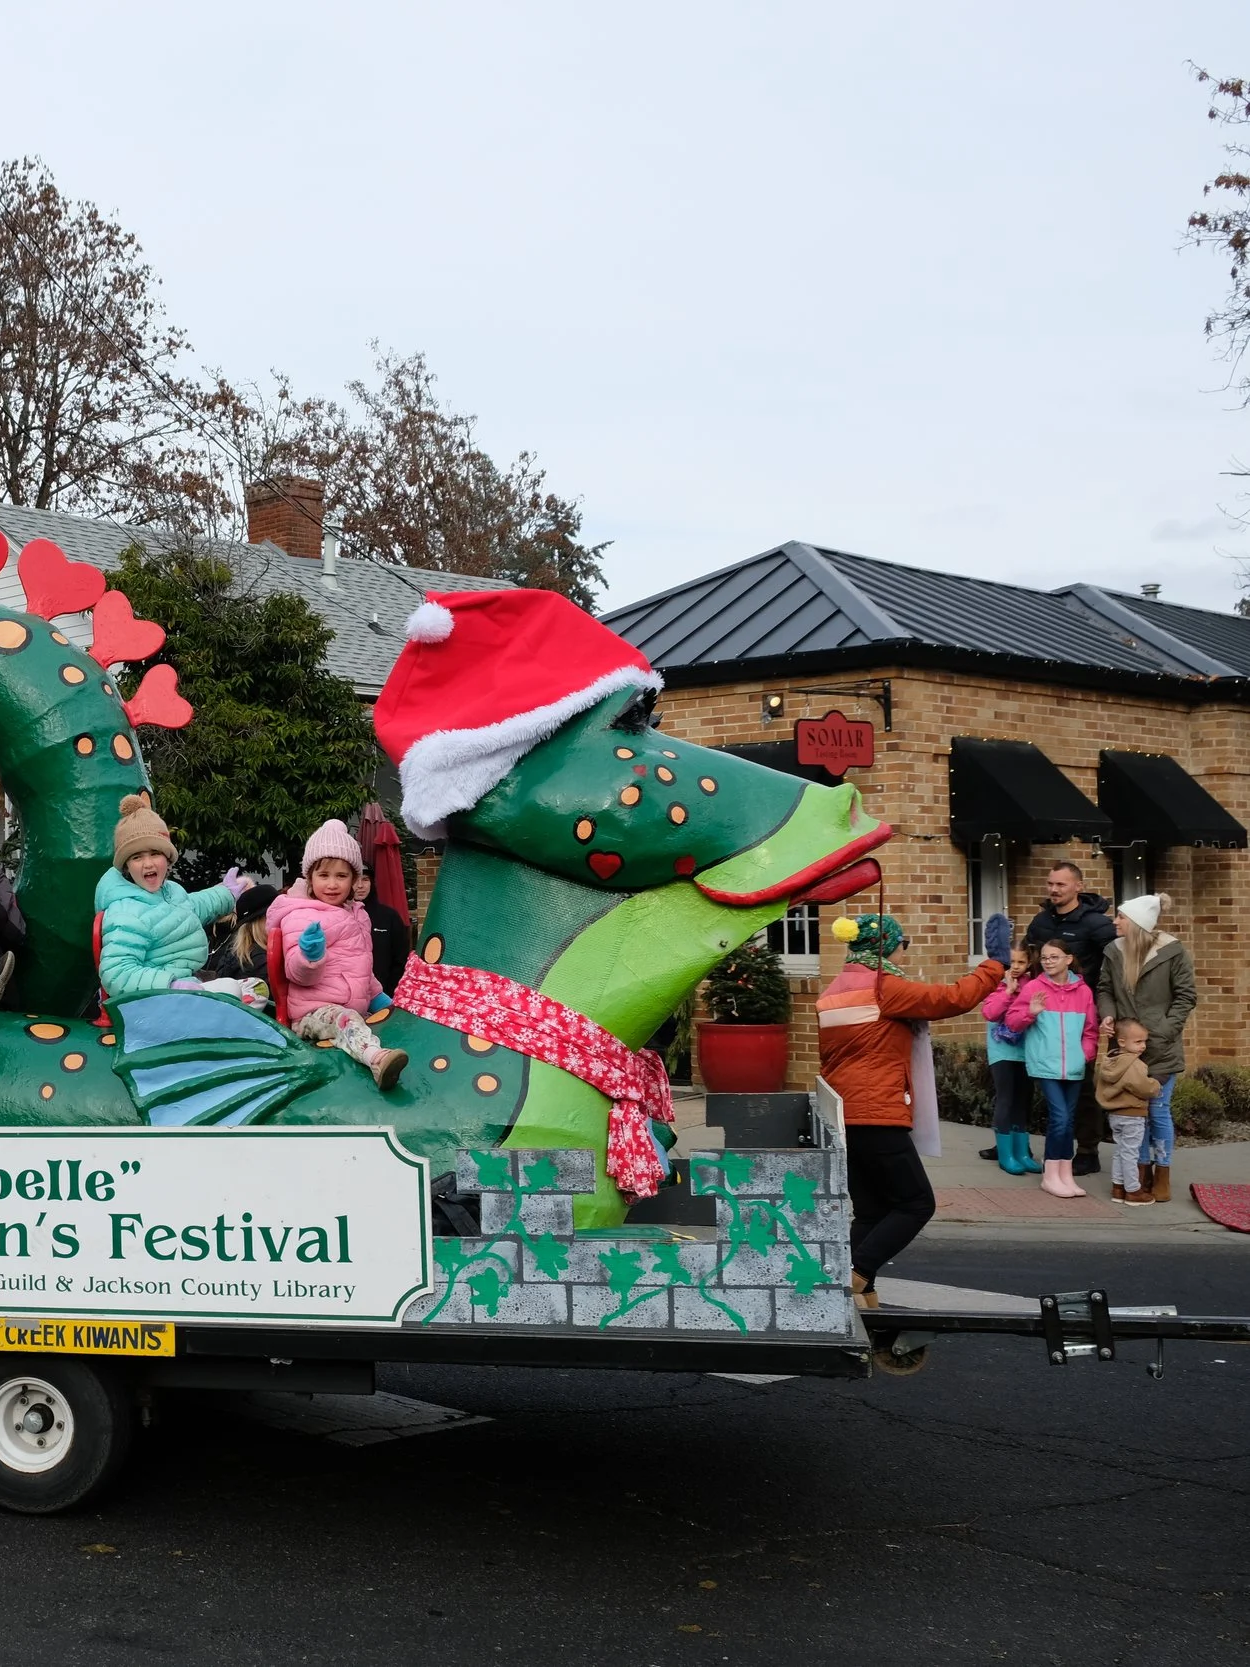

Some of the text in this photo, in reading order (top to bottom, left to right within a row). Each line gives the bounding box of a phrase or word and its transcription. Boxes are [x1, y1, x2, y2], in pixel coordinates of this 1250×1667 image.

[807, 727, 863, 747] SOMAR
[107, 1211, 353, 1264] Festival
[55, 1275, 74, 1293] &
[82, 1276, 171, 1295] Jackson
[181, 1278, 262, 1302] County
[273, 1279, 356, 1304] Library
[5, 1324, 67, 1348] CREEK
[73, 1325, 162, 1351] KIWANIS
